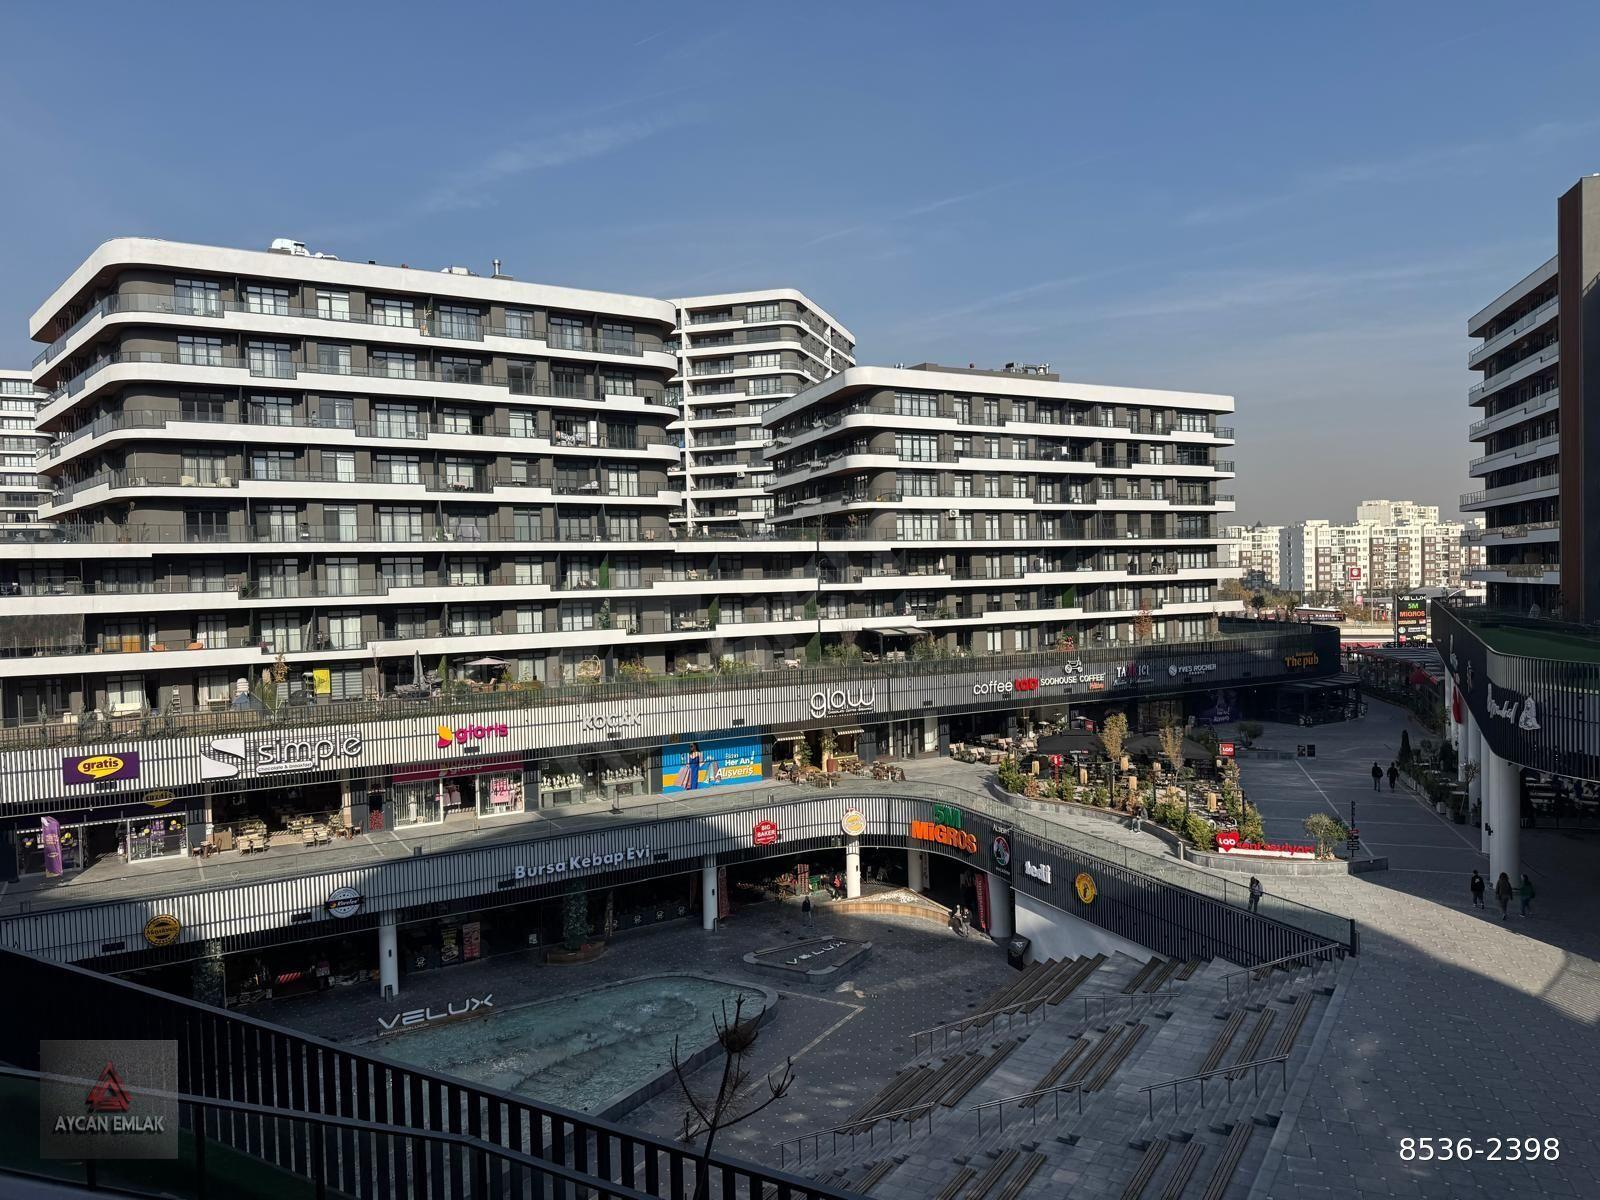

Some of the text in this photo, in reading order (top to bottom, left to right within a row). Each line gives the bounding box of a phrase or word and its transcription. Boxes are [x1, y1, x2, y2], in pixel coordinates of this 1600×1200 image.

[1178, 663, 1217, 673] YVES ROCHER
[1284, 655, 1302, 667] The
[1302, 652, 1319, 669] pub
[1079, 673, 1105, 683] COFFEE
[973, 680, 1013, 695] coffee
[811, 687, 875, 718] glow
[258, 732, 362, 766] simple
[83, 758, 119, 772] gratis
[724, 759, 738, 767] Her
[934, 804, 961, 829] 5M
[757, 830, 776, 838] BAKER
[515, 844, 650, 879] Bursa Kebap Evi
[377, 993, 494, 1030] VELUX
